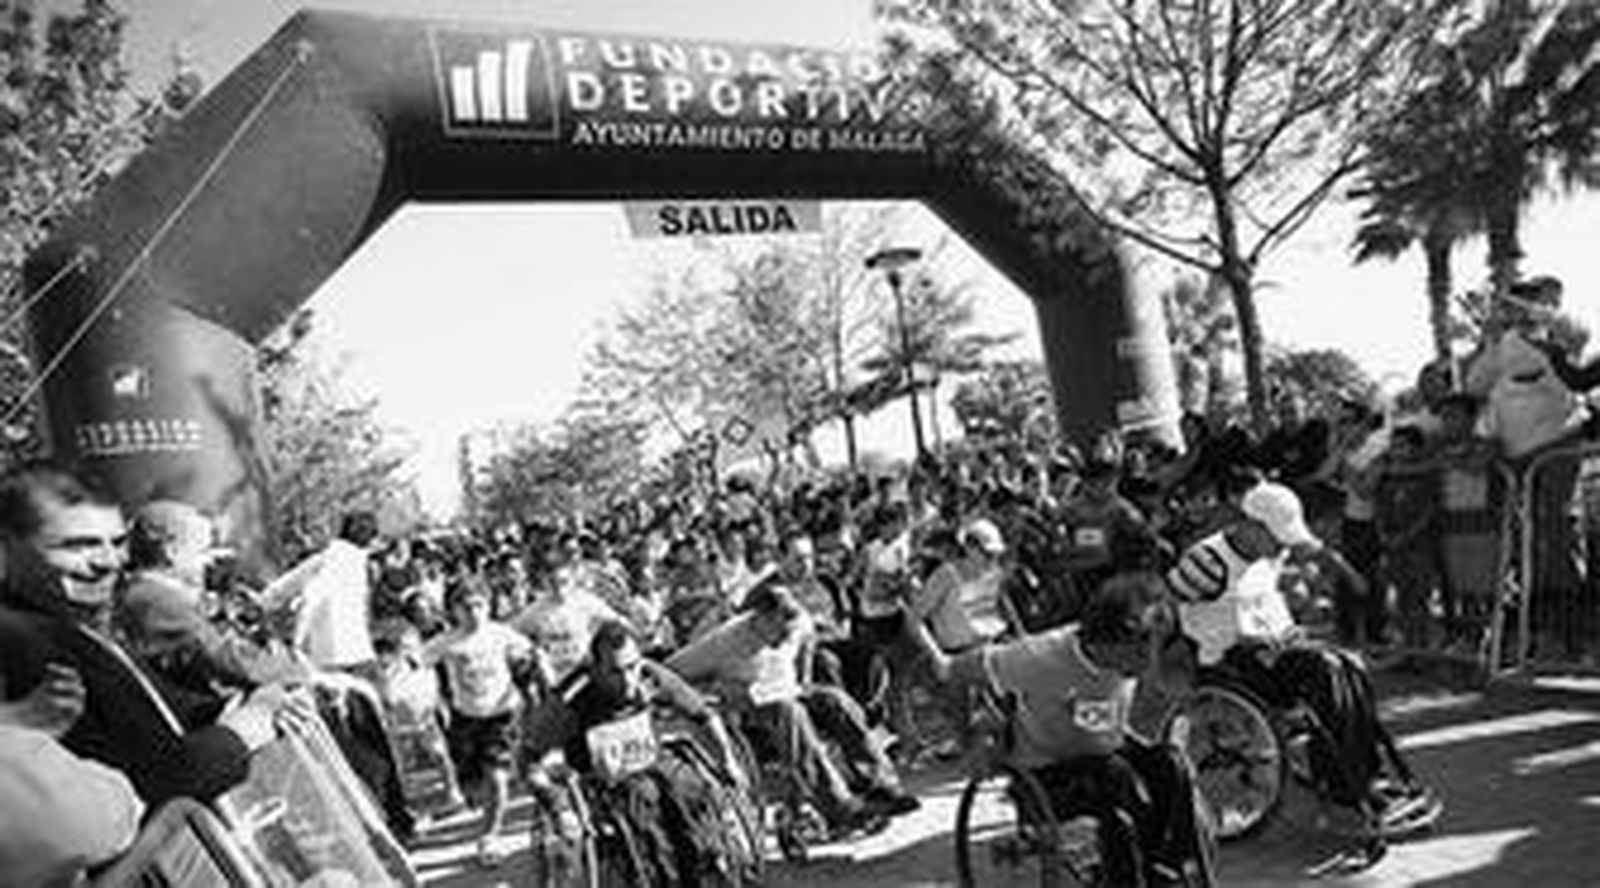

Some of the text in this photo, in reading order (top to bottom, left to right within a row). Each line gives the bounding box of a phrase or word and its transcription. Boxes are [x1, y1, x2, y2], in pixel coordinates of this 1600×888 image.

[572, 122, 785, 150] AYUNTAMIENTO
[791, 127, 822, 150] DE
[658, 203, 798, 236] SALIDA
